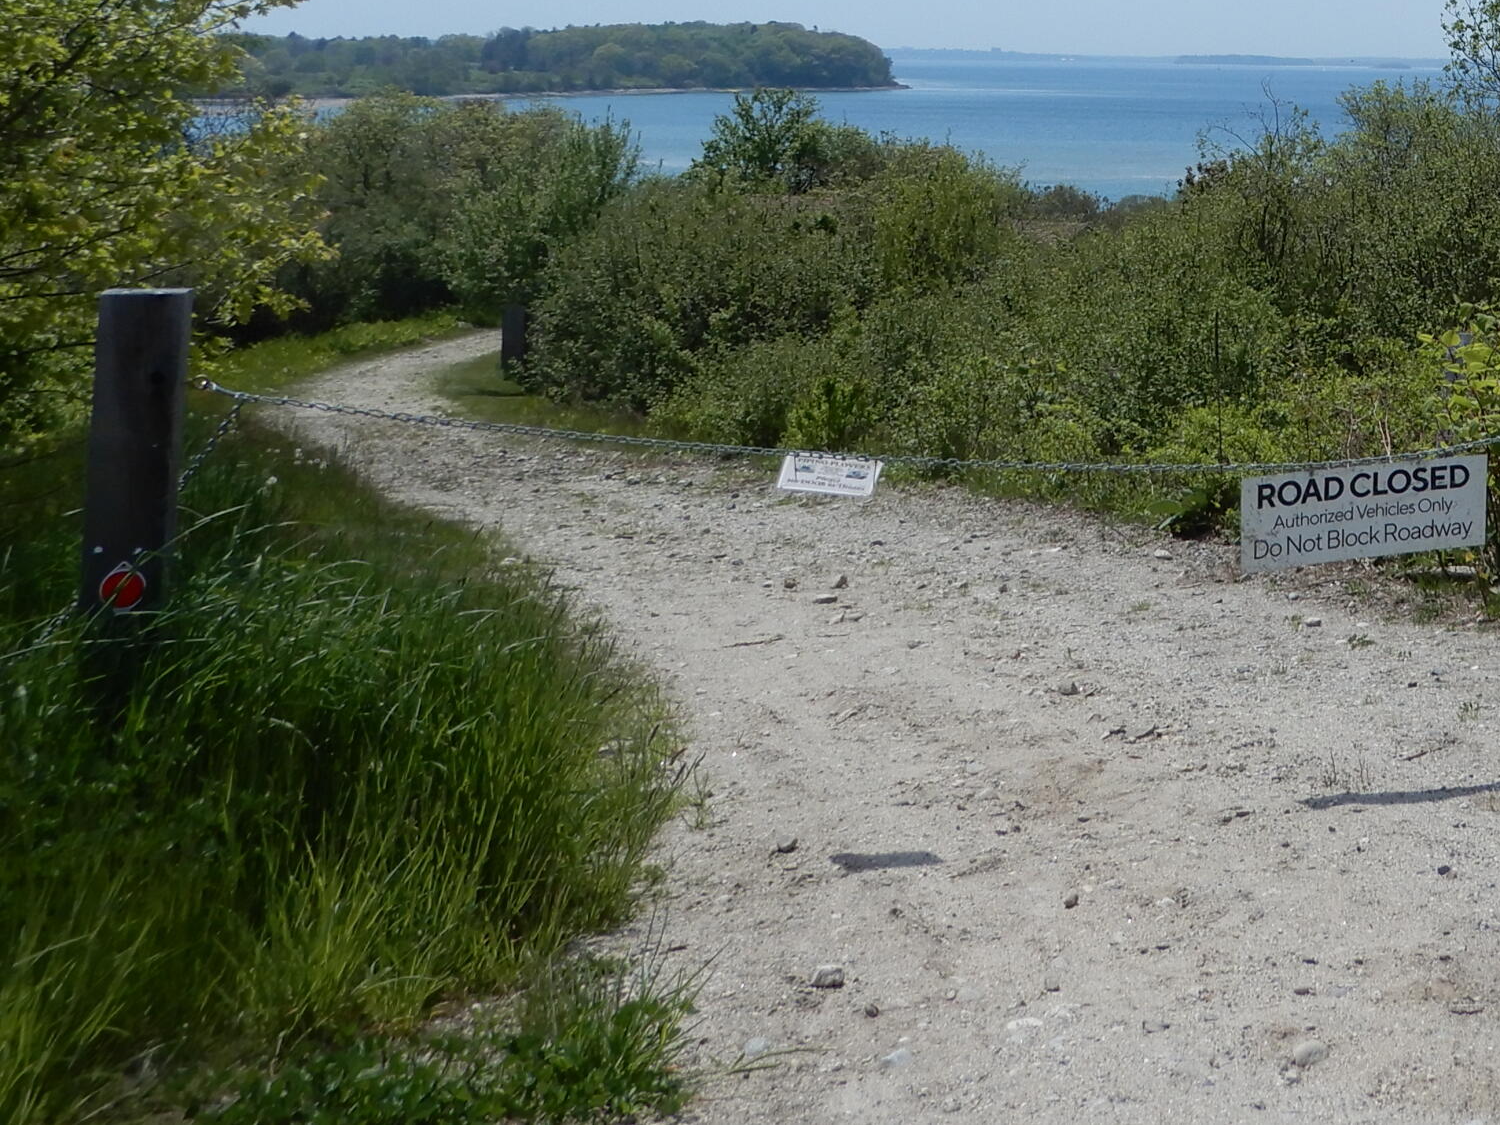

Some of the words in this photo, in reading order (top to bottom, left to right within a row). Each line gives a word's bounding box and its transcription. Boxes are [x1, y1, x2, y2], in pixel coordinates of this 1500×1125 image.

[1257, 476, 1344, 509] ROAD
[1350, 464, 1470, 498] CLOSED
[1273, 506, 1353, 530] Authorized
[1356, 500, 1416, 520] Vehicles
[1418, 496, 1453, 515] Only
[1254, 540, 1282, 560] Do
[1287, 533, 1323, 555] Not
[1327, 526, 1380, 550] Block
[1384, 520, 1473, 543] Roadway
